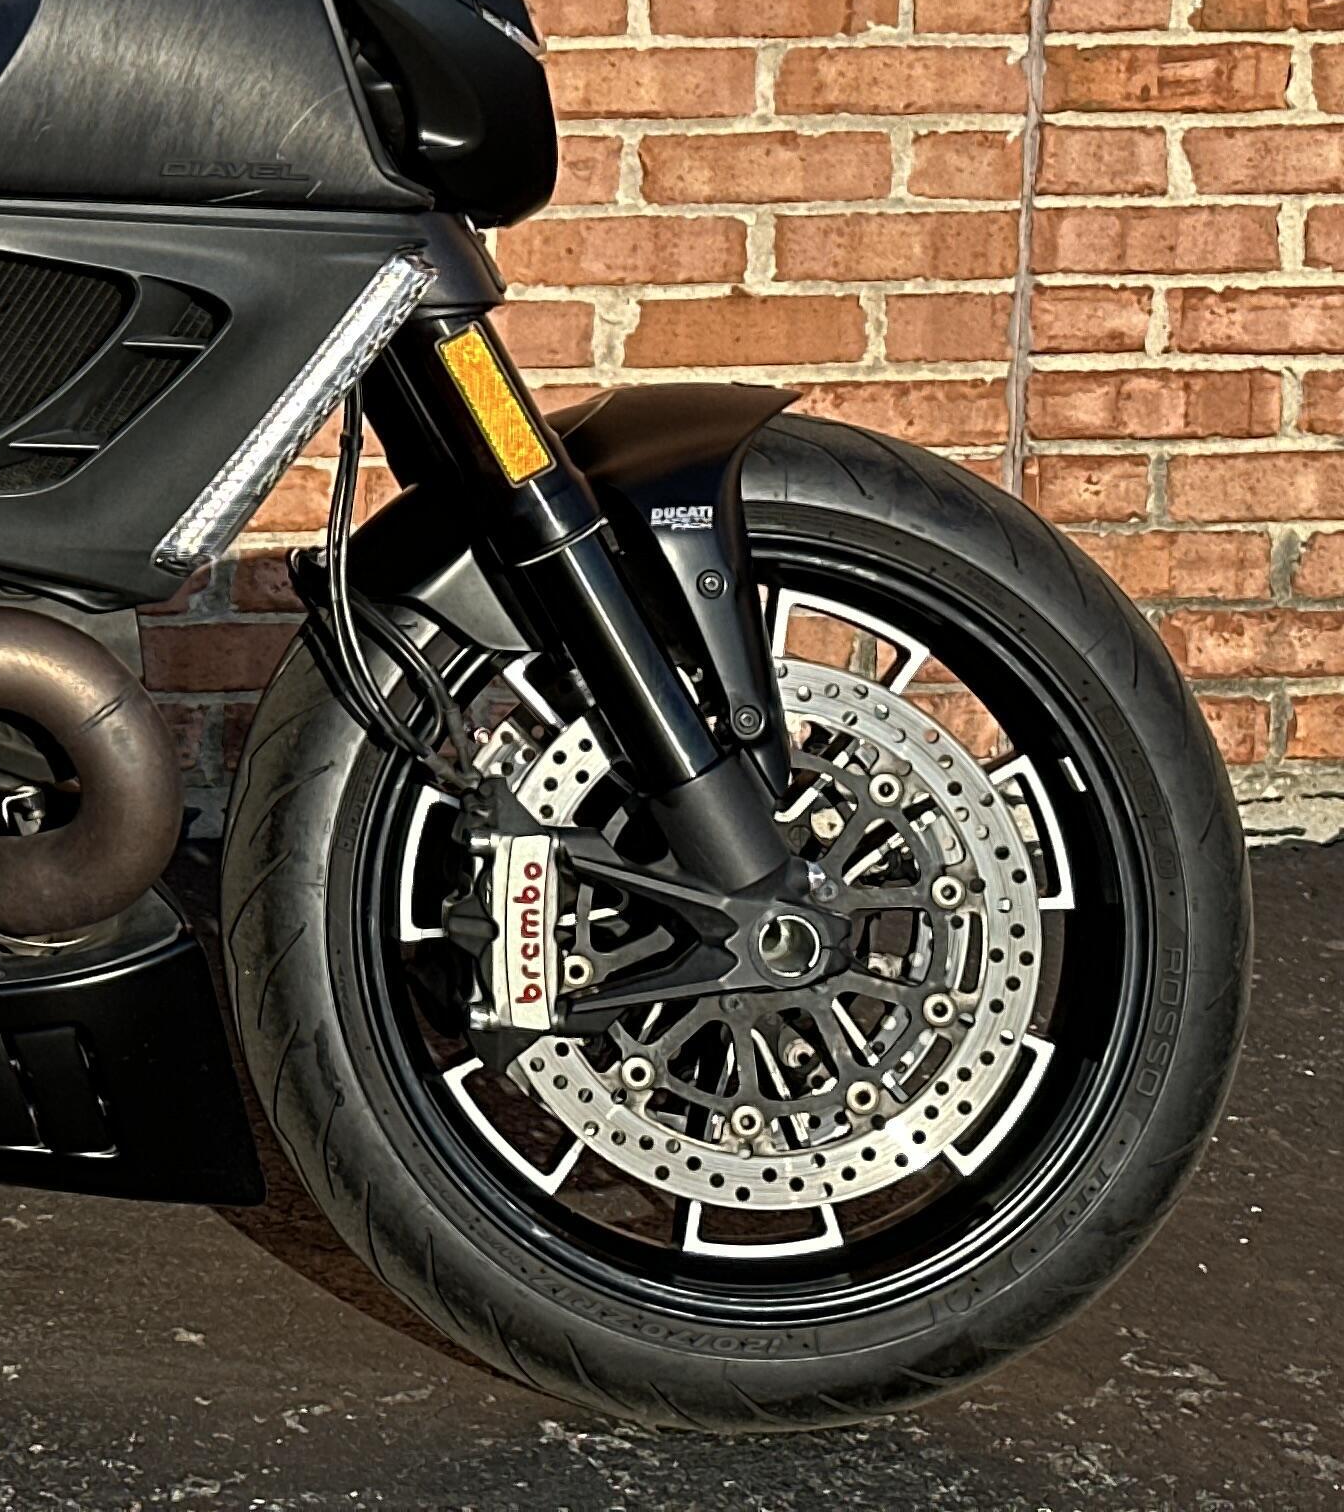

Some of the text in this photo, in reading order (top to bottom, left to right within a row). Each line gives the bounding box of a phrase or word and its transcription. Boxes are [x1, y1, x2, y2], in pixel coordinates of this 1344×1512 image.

[161, 161, 310, 181] DIAVEL
[651, 506, 714, 519] DUCATI
[1136, 948, 1184, 1097] ROSSO
[641, 1323, 783, 1354] 120/70
